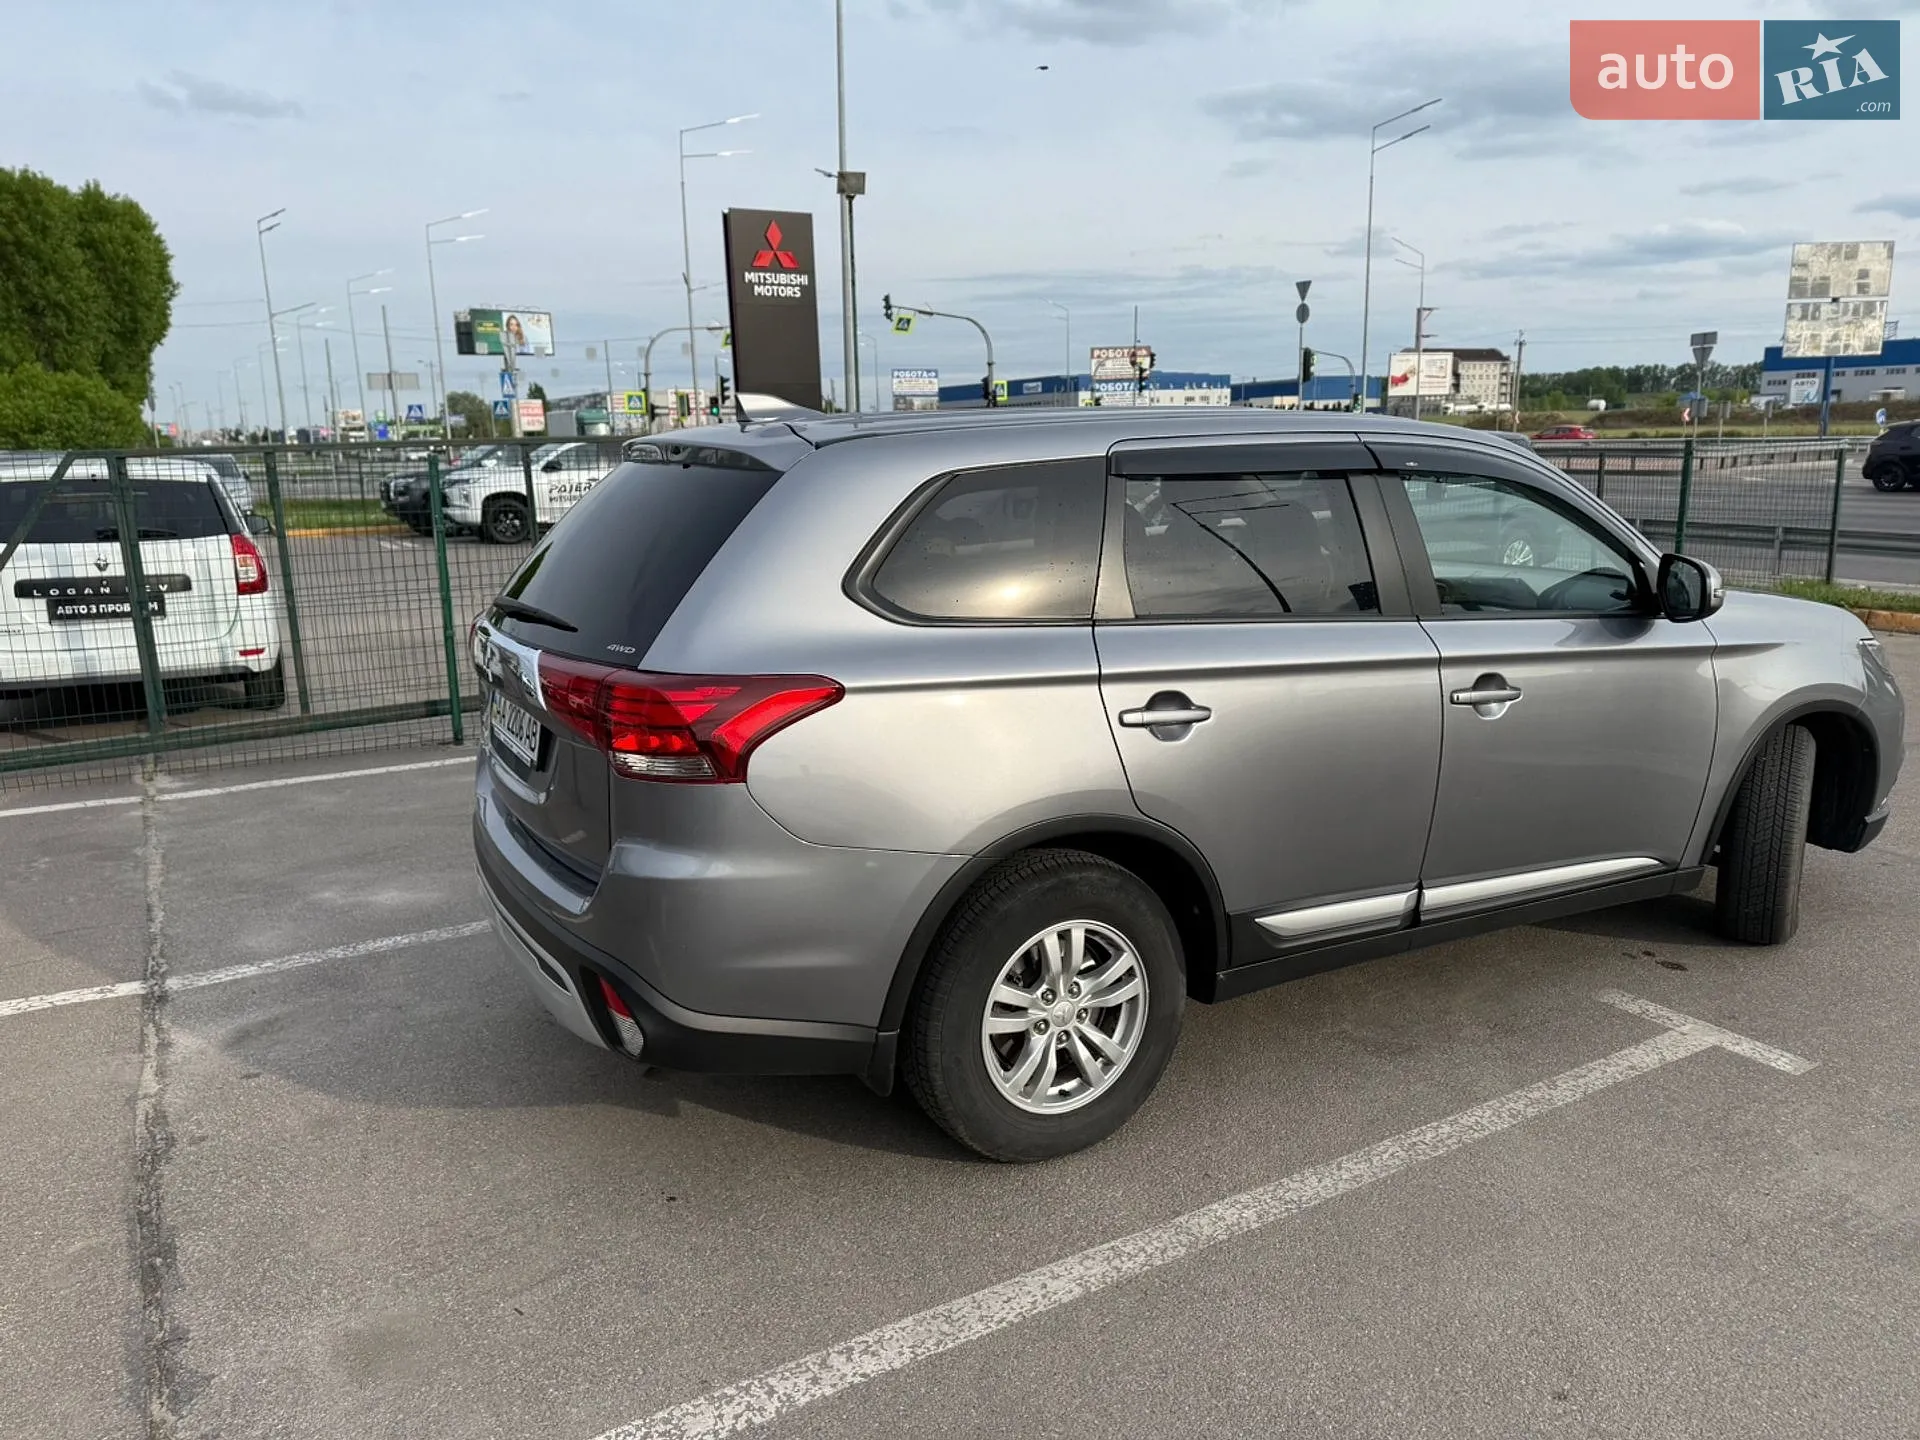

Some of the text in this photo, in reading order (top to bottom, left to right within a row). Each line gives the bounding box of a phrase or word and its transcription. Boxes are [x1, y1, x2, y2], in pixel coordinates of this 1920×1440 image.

[744, 271, 809, 286] MITSUBISHI
[754, 285, 802, 298] MOTORS
[893, 370, 928, 378] РОБОТА
[33, 585, 111, 596] LOGAN
[56, 604, 88, 615] АВТО
[606, 643, 636, 654] 4WD
